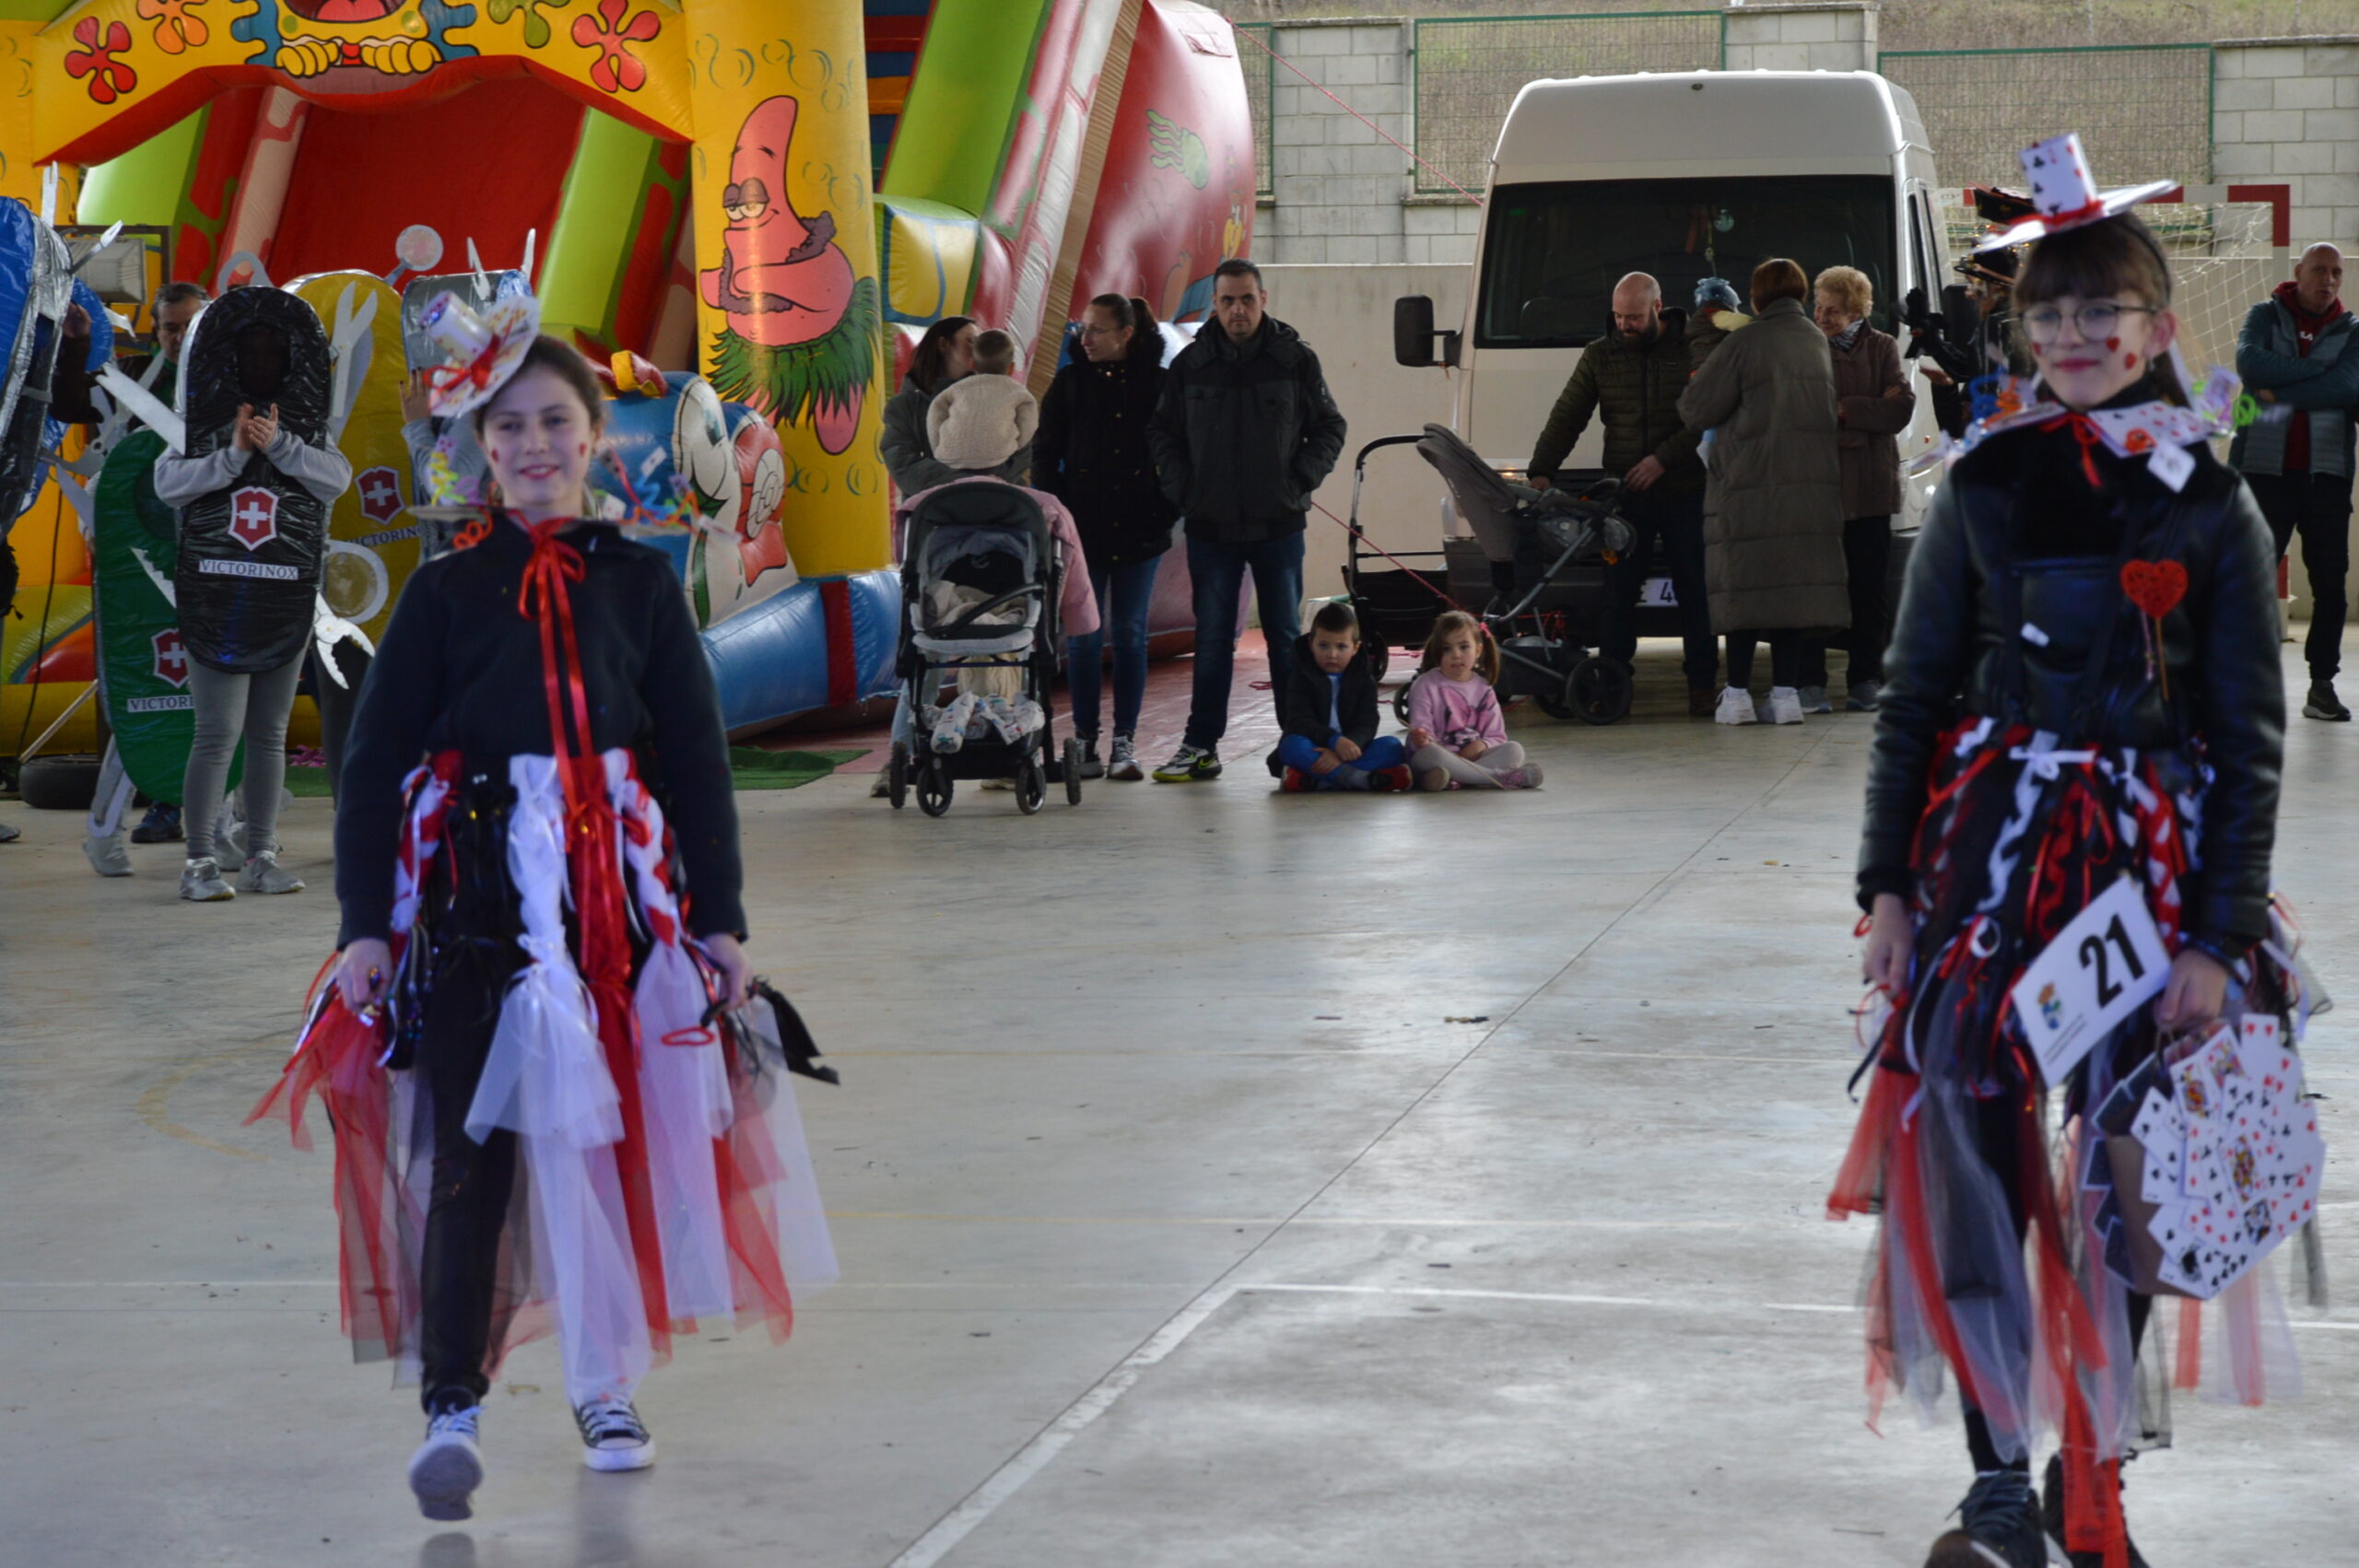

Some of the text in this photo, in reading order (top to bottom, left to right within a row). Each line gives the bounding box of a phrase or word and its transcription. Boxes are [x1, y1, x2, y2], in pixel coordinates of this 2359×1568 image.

[348, 525, 421, 545] ICTORIN
[200, 560, 296, 579] VICTORINOX
[1659, 581, 1672, 603] 4
[129, 695, 194, 710] VICTORI
[2079, 912, 2146, 1009] 21
